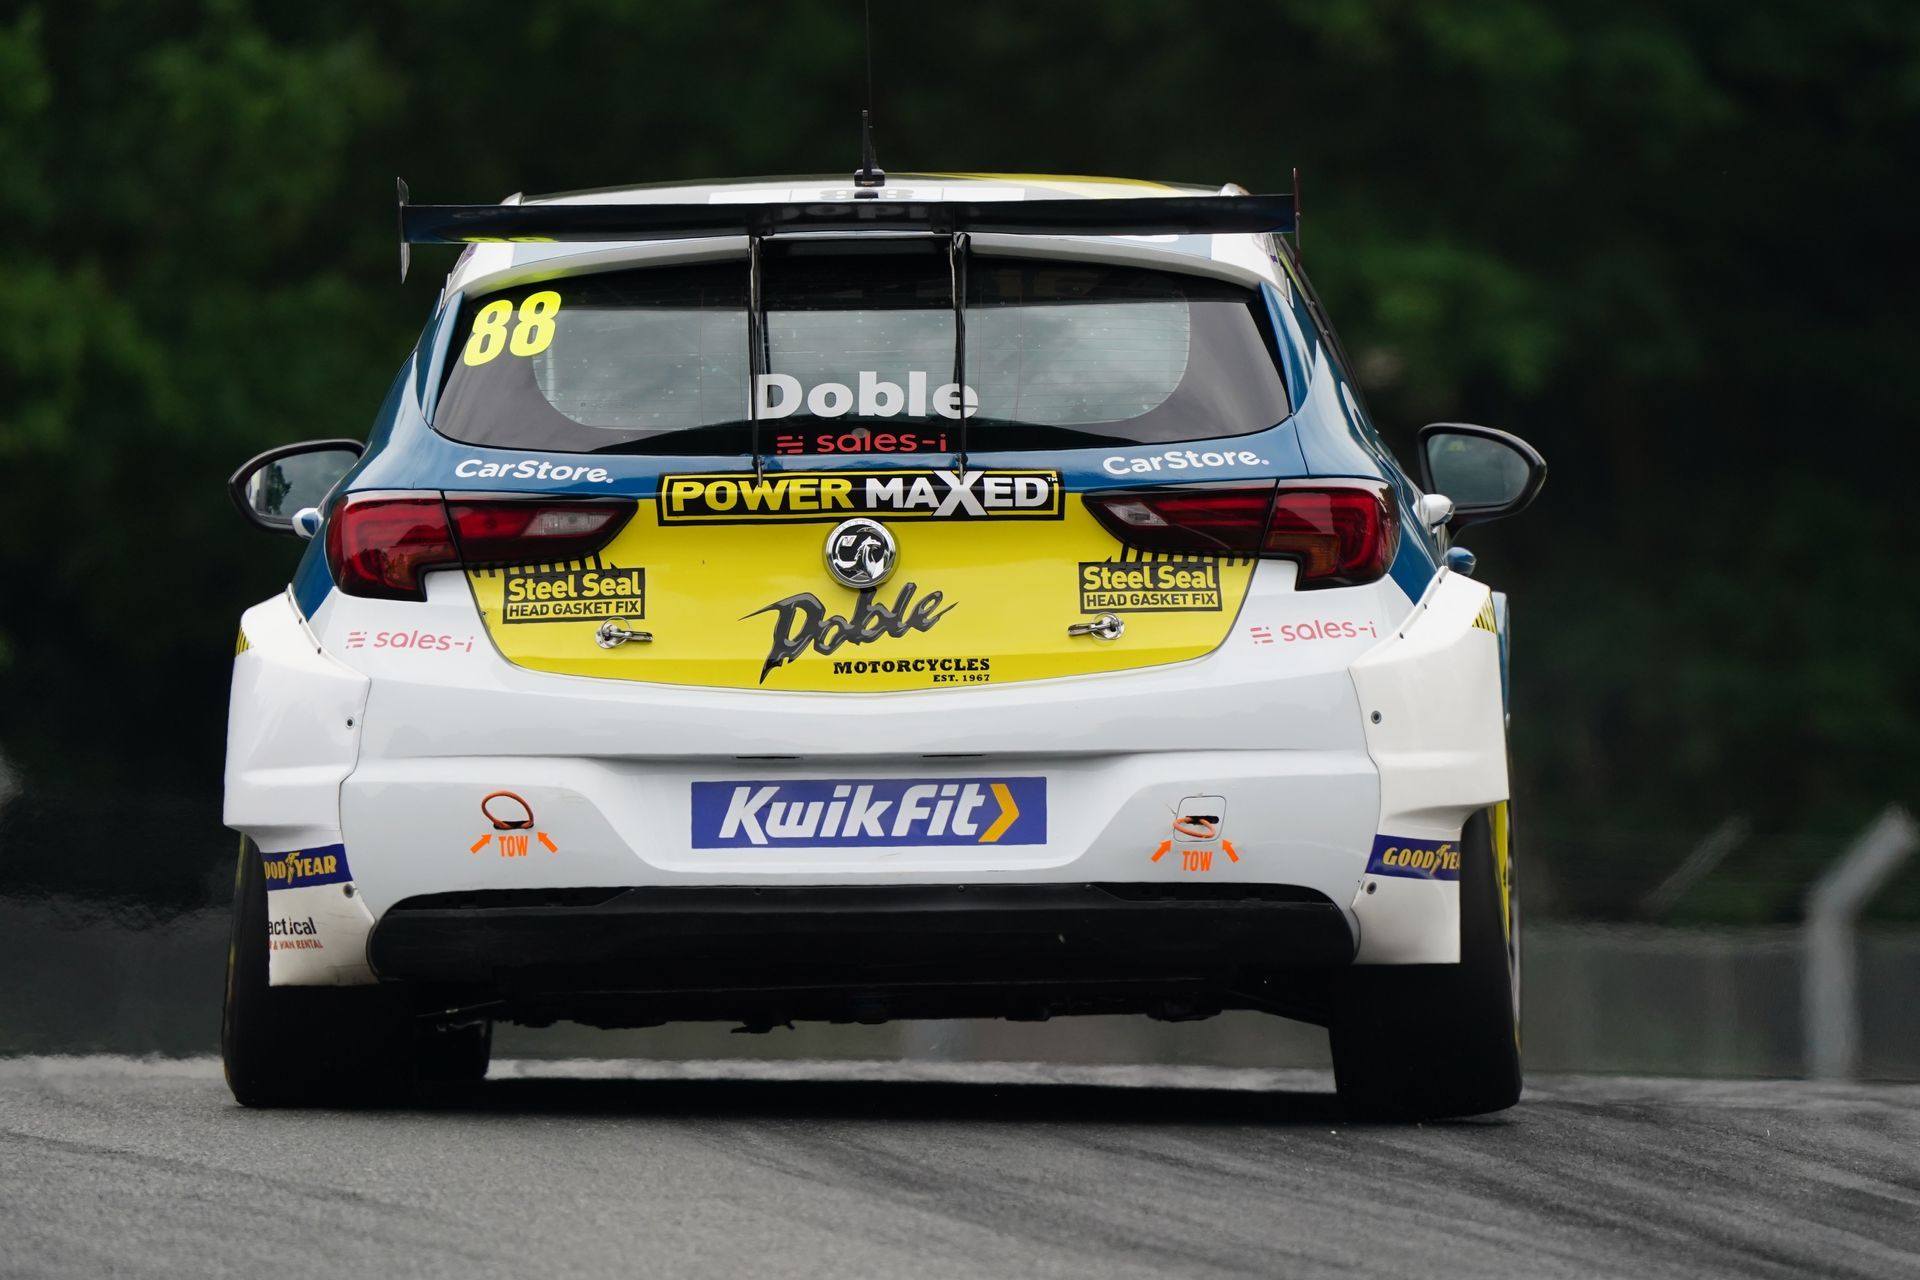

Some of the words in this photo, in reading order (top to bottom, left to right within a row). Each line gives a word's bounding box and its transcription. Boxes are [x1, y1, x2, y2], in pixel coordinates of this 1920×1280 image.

[463, 290, 562, 367] 88
[748, 371, 979, 420] Doble
[816, 431, 947, 453] sales-i
[454, 459, 614, 484] CarStore.
[1102, 449, 1270, 475] CarStore.
[671, 478, 854, 512] POWER
[508, 574, 578, 602] Steel
[582, 571, 642, 597] Seal
[1083, 565, 1154, 591] Steel
[1157, 565, 1216, 589] Seal
[509, 603, 549, 617] HEAD
[552, 601, 612, 615] GASKET
[615, 600, 639, 613] FIX
[1086, 594, 1127, 607] HEAD
[1130, 593, 1188, 606] GASKET
[1192, 593, 1215, 605] FIX
[373, 629, 475, 653] sales-i
[1280, 619, 1377, 642] sales-i
[833, 658, 990, 674] MOTORCYCLES
[933, 674, 958, 682] EST.
[962, 674, 990, 682] 1967
[498, 834, 529, 858] TOW
[1182, 850, 1213, 872] TOW
[296, 938, 324, 949] RENTAL
